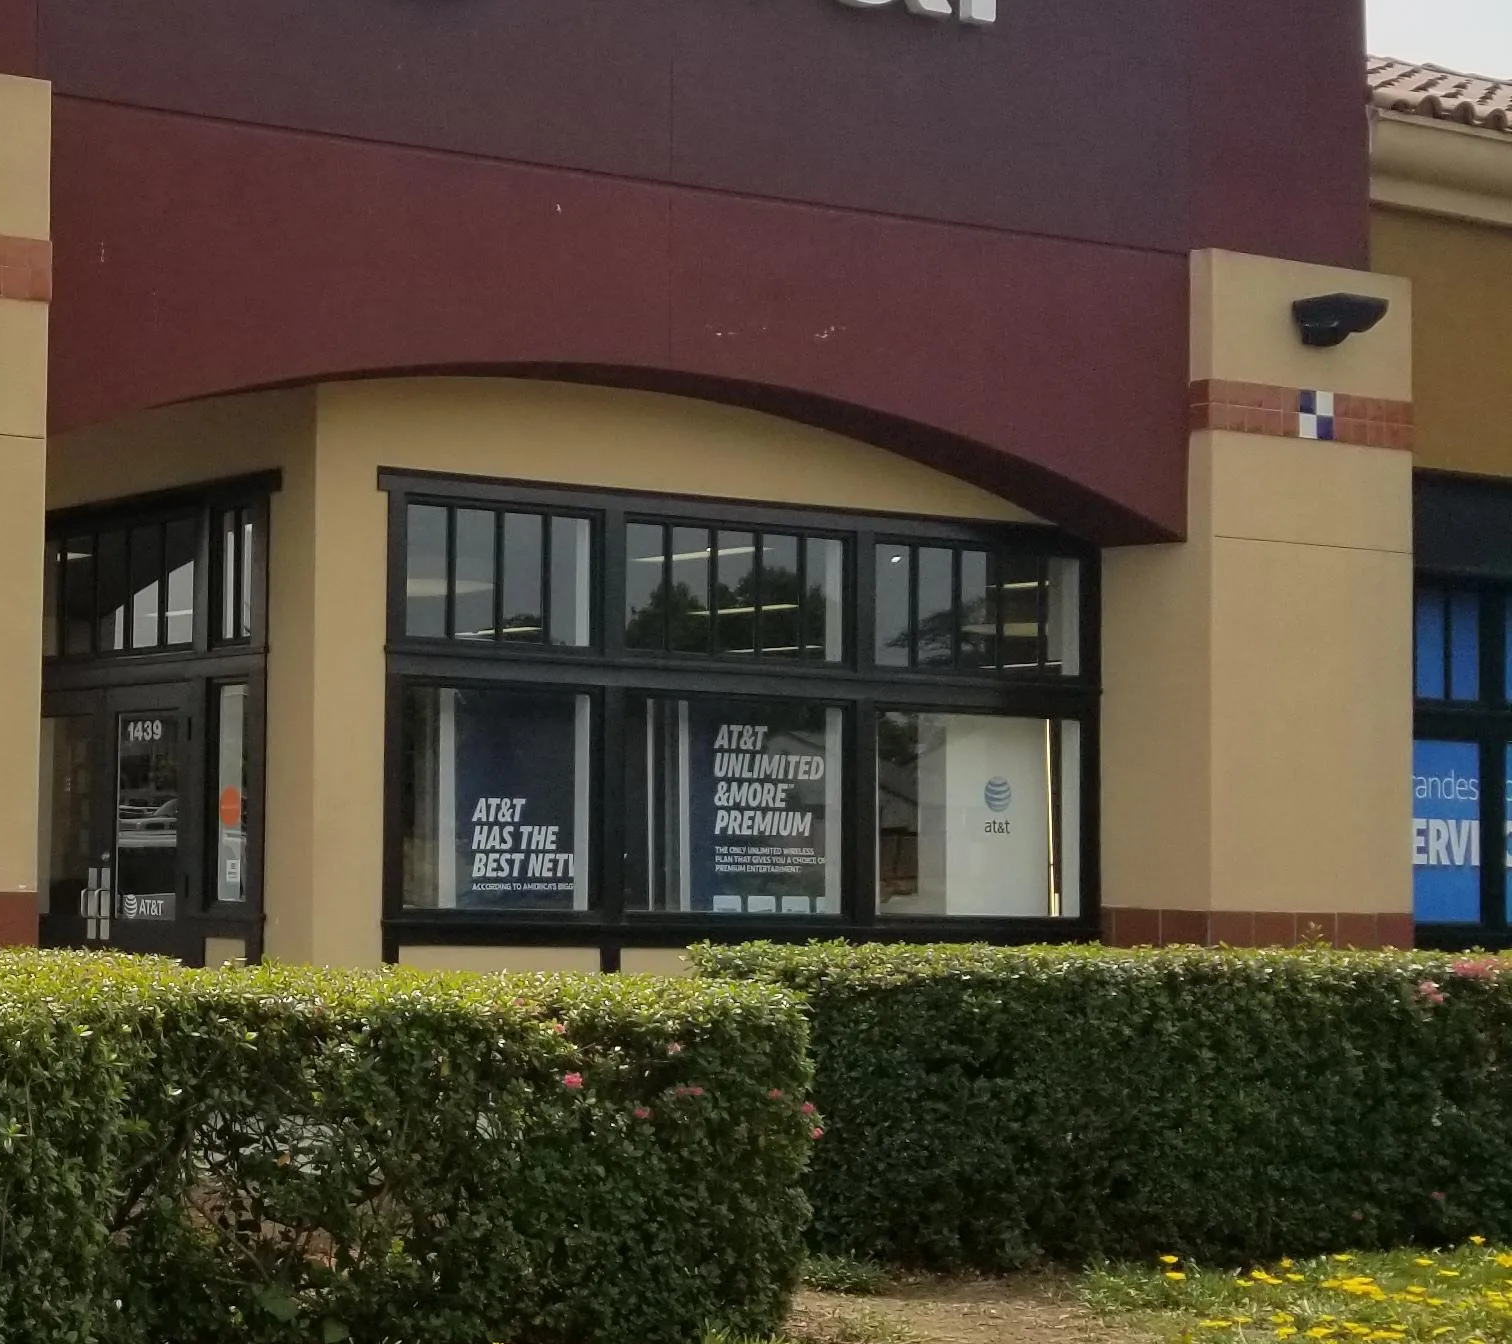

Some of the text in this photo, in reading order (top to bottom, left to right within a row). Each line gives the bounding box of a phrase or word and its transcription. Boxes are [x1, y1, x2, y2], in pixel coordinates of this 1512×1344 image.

[127, 719, 163, 741] 1439
[713, 724, 768, 750] AT&T
[714, 752, 825, 780] UNLIMITED
[1412, 769, 1480, 801] andes
[471, 797, 527, 822] AT&T
[714, 809, 813, 836] PREMIUM
[984, 820, 1011, 834] at&t
[471, 825, 559, 850] HAS THE
[471, 853, 525, 877] BEST
[715, 855, 733, 864] PLAN
[734, 855, 751, 864] THAT
[772, 856, 786, 864] YOU
[715, 864, 746, 873] PREMIUM
[472, 882, 512, 891] ACCORDING
[138, 898, 165, 916] AT&T
